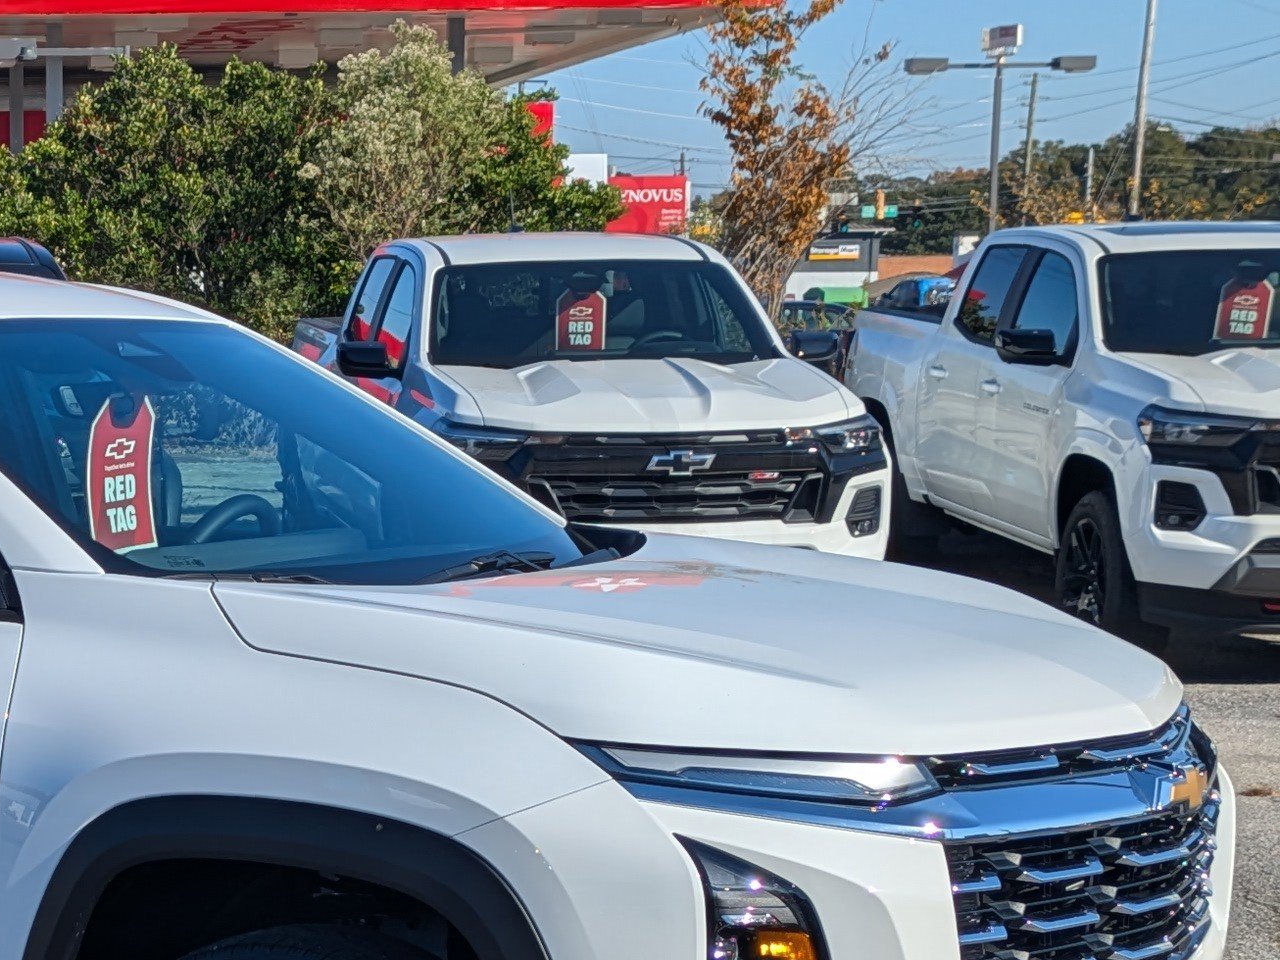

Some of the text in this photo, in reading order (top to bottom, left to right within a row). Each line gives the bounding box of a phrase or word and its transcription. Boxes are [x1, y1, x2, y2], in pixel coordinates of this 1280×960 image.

[621, 188, 683, 203] YNOVUS
[1230, 309, 1258, 322] RED
[568, 321, 594, 333] RED
[1229, 322, 1254, 335] TAG
[568, 334, 592, 345] TAG
[104, 473, 136, 504] RED
[106, 505, 137, 534] TAG
